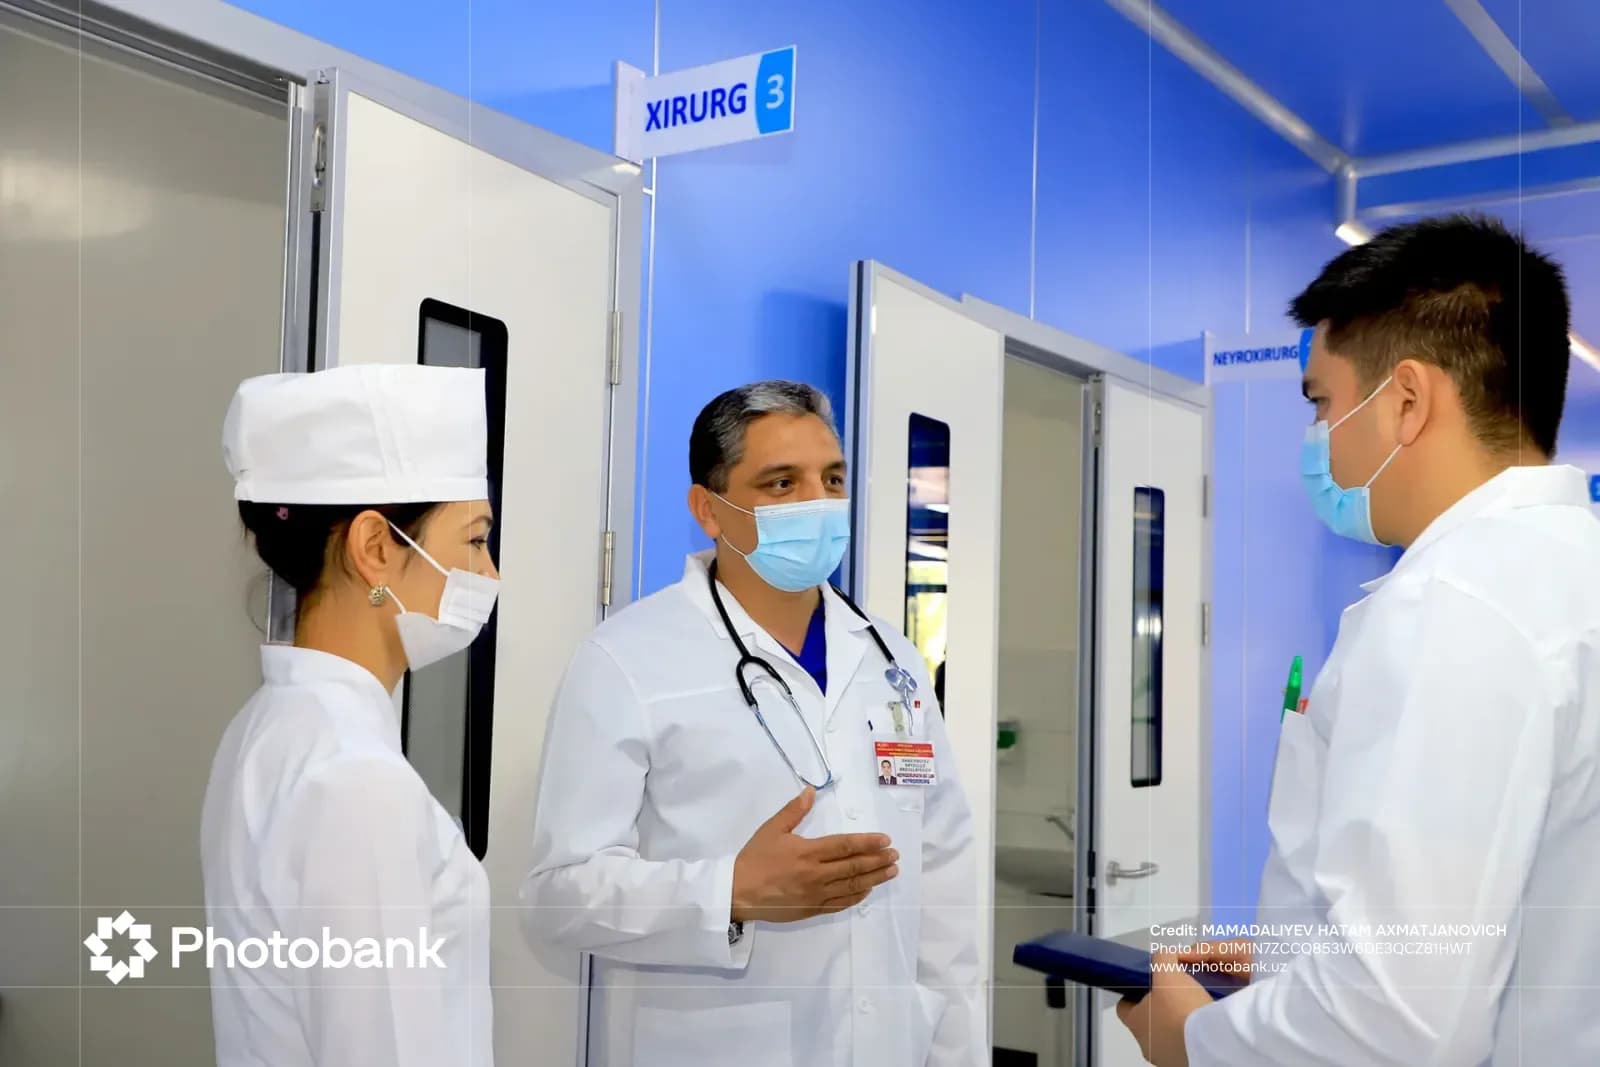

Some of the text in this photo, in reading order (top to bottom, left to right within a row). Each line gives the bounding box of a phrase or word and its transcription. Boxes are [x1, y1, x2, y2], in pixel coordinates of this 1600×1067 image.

[645, 73, 785, 132] XIRURG 3
[1213, 346, 1298, 365] NEYROXIRURG
